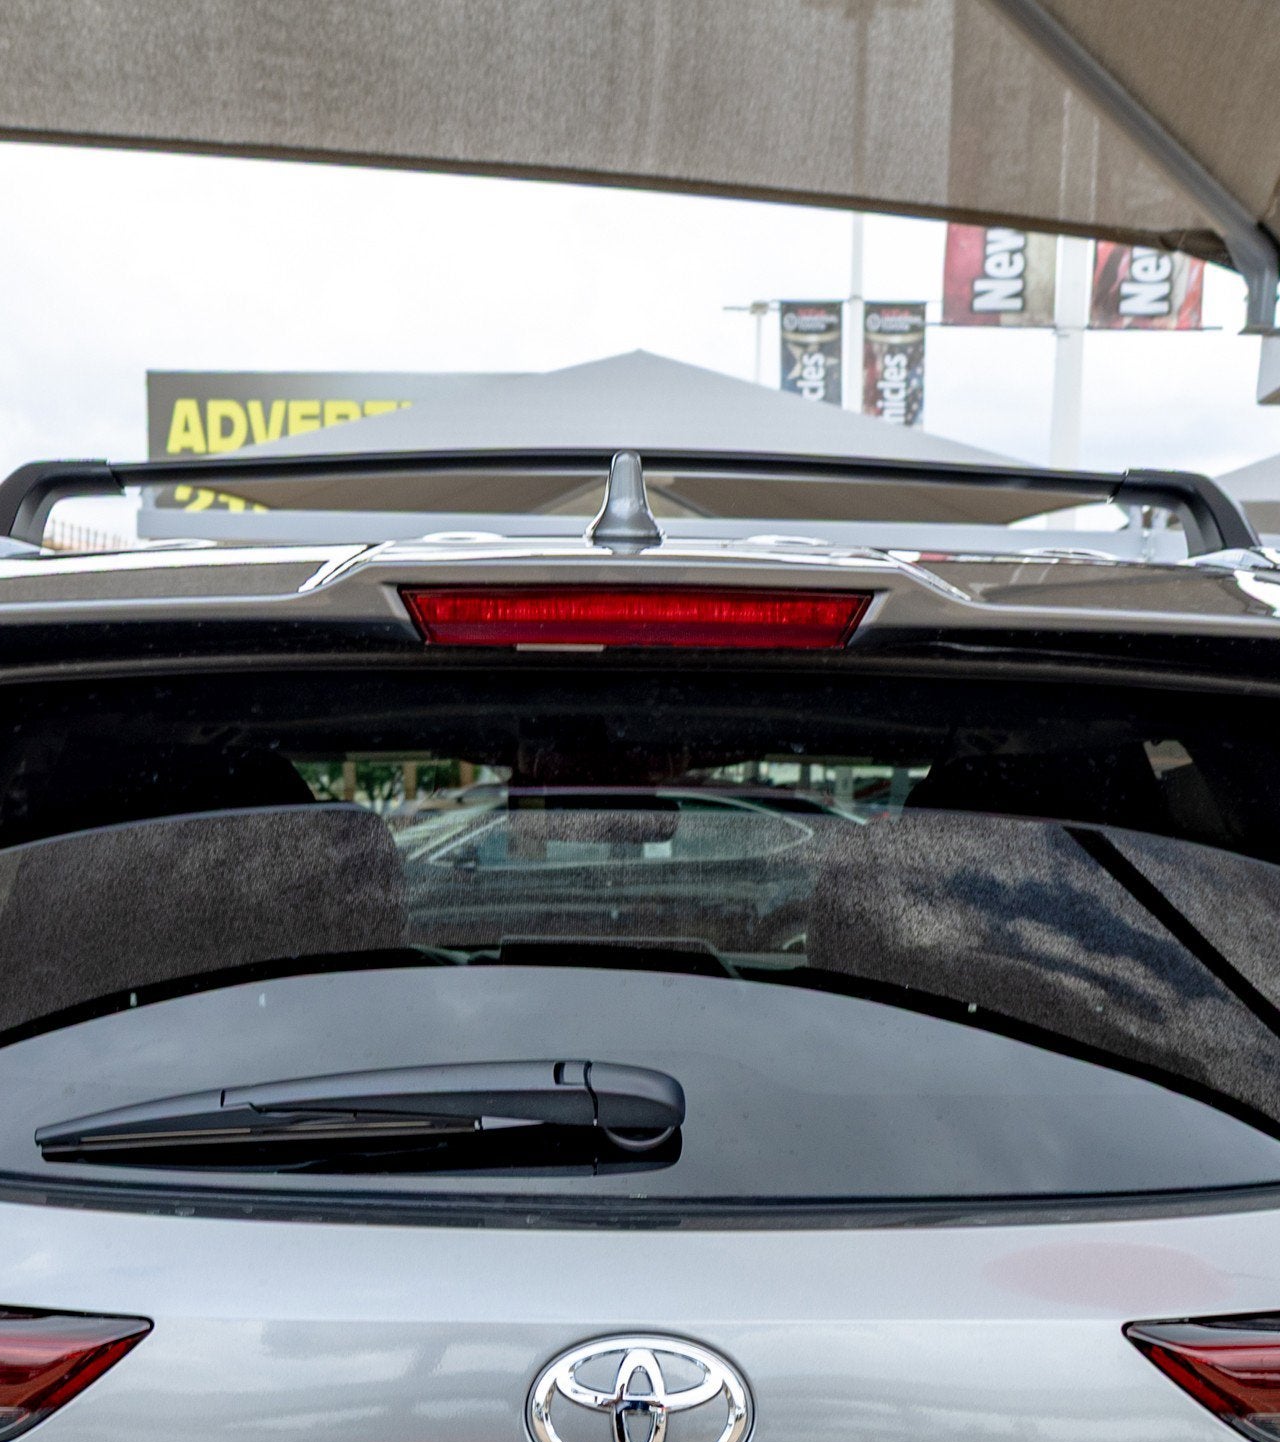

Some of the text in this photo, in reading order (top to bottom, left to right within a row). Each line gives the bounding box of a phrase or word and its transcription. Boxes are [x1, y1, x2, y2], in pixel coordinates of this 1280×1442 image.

[1119, 246, 1172, 315] Ne
[796, 352, 826, 401] cles
[166, 398, 414, 453] ADVE
